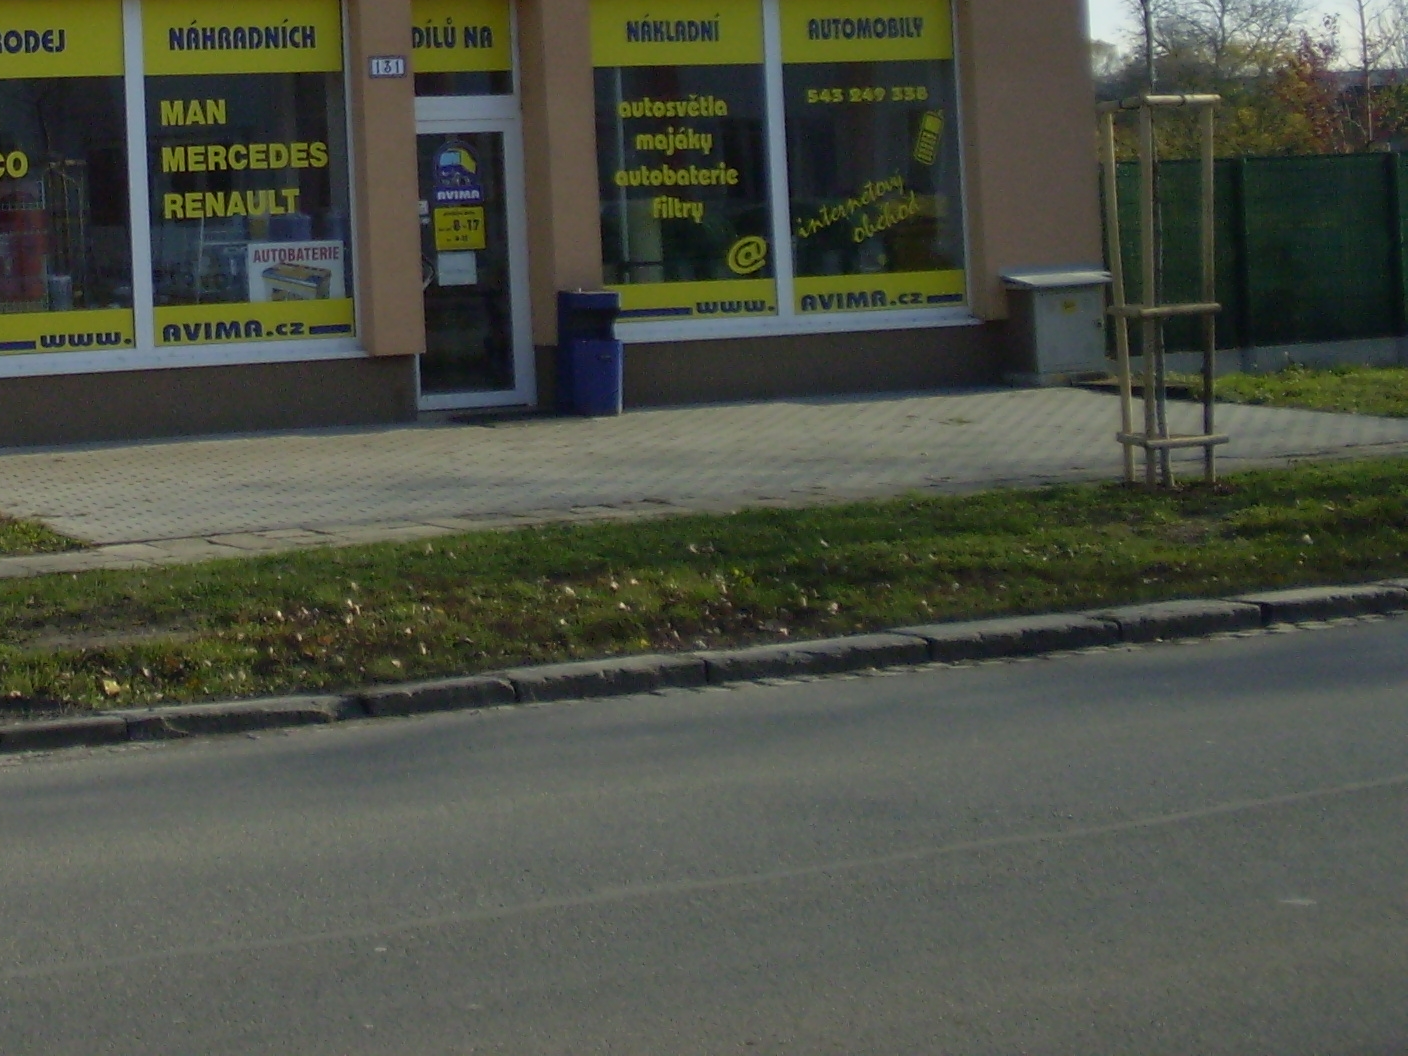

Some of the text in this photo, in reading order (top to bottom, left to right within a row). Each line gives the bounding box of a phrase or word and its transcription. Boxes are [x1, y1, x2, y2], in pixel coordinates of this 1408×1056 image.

[168, 18, 316, 51] NÁHRADNÍCH
[412, 17, 457, 49] DÍLŮ
[464, 26, 493, 48] NA
[626, 13, 720, 43] NÁKLADNÍ
[808, 17, 924, 41] AUTOMOBILY
[374, 59, 402, 75] 131
[617, 94, 728, 118] autosvětla
[808, 88, 844, 103] 543
[161, 99, 227, 126] MAN
[635, 127, 713, 156] majáky
[162, 142, 328, 173] MERCEDES
[614, 162, 739, 187] autobaterie
[164, 188, 300, 220] RENAULT
[437, 189, 480, 201] AVIMA
[652, 195, 705, 223] filtry
[253, 246, 340, 263] AUTOBATERIE
[727, 236, 767, 274] @
[696, 290, 924, 314] www. AVIMA.cz
[40, 319, 305, 348] www. AVIMA.cz
